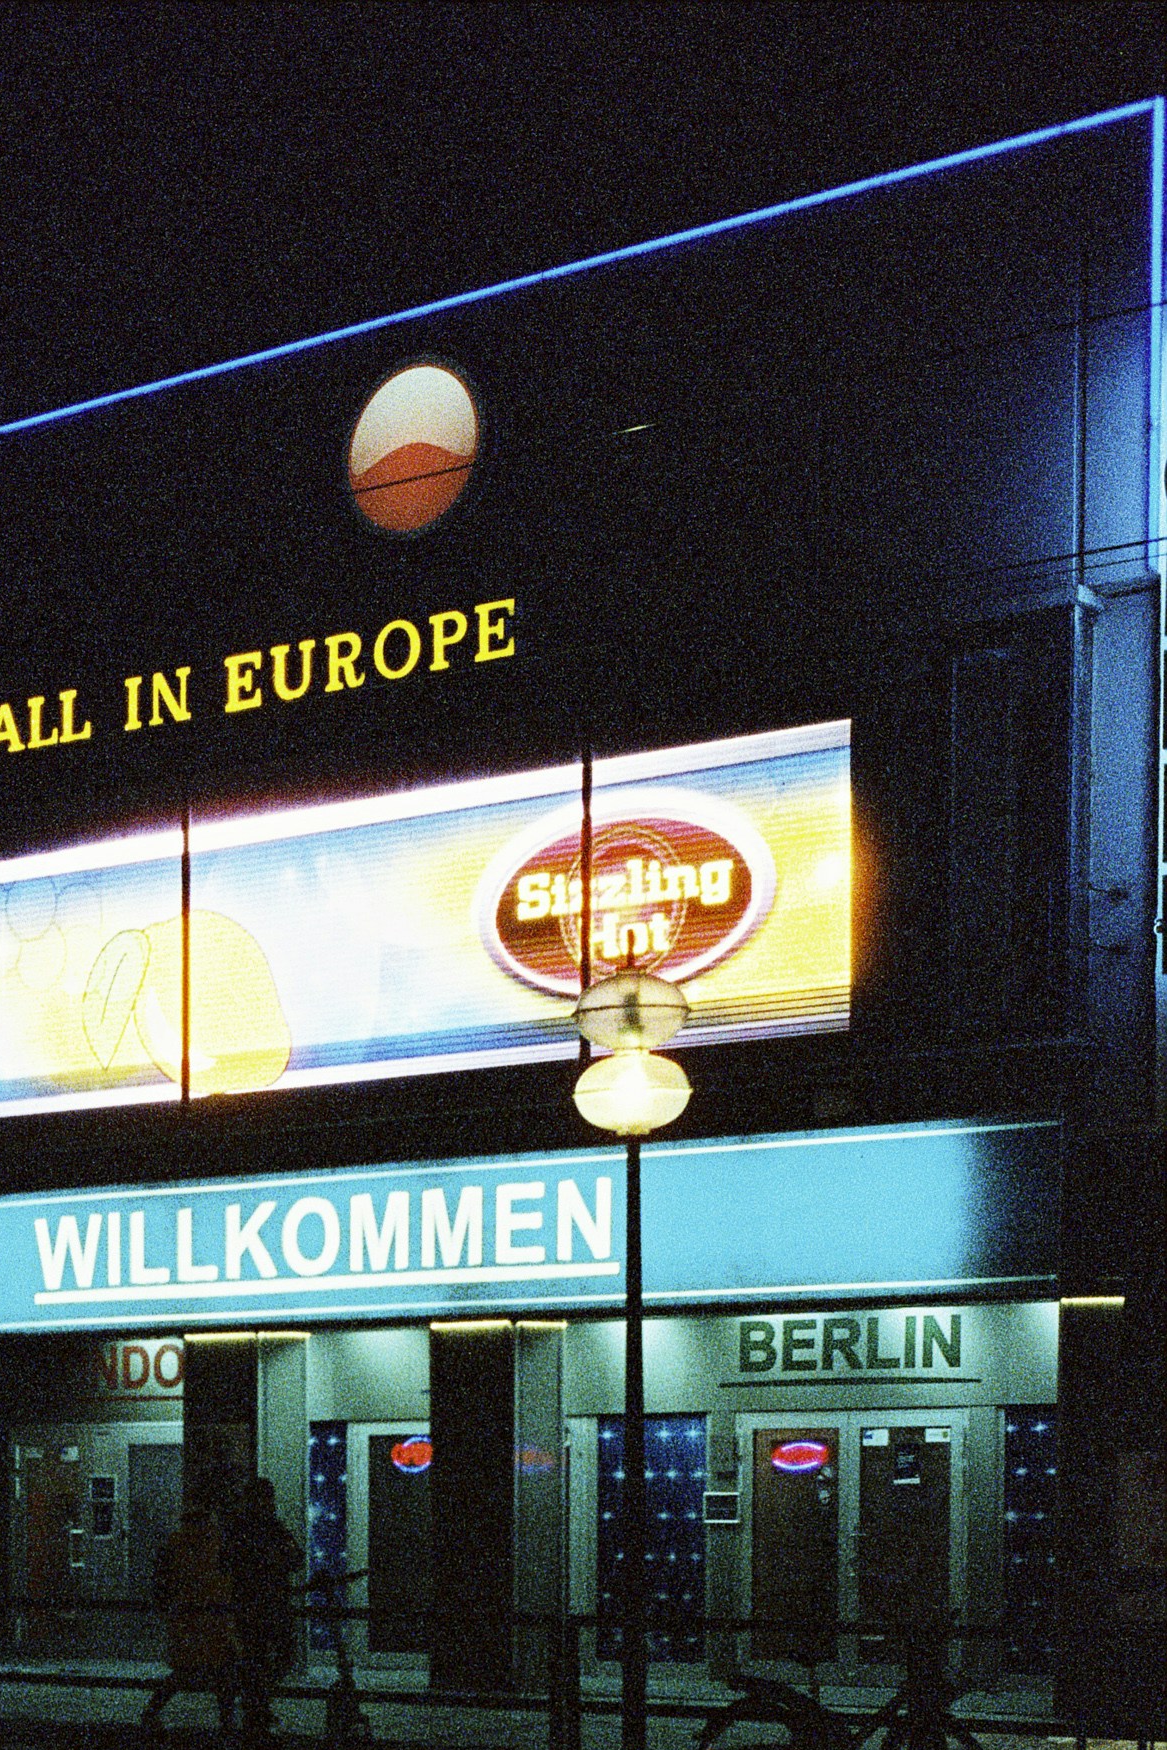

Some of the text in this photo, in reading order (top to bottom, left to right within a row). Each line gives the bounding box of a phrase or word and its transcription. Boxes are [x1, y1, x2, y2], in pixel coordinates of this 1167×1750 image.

[124, 667, 191, 731] IN
[224, 599, 515, 713] EUROPE
[517, 858, 734, 921] Sizzling
[34, 1176, 612, 1291] WILLKOMMEN
[739, 1314, 962, 1373] BERLIN
